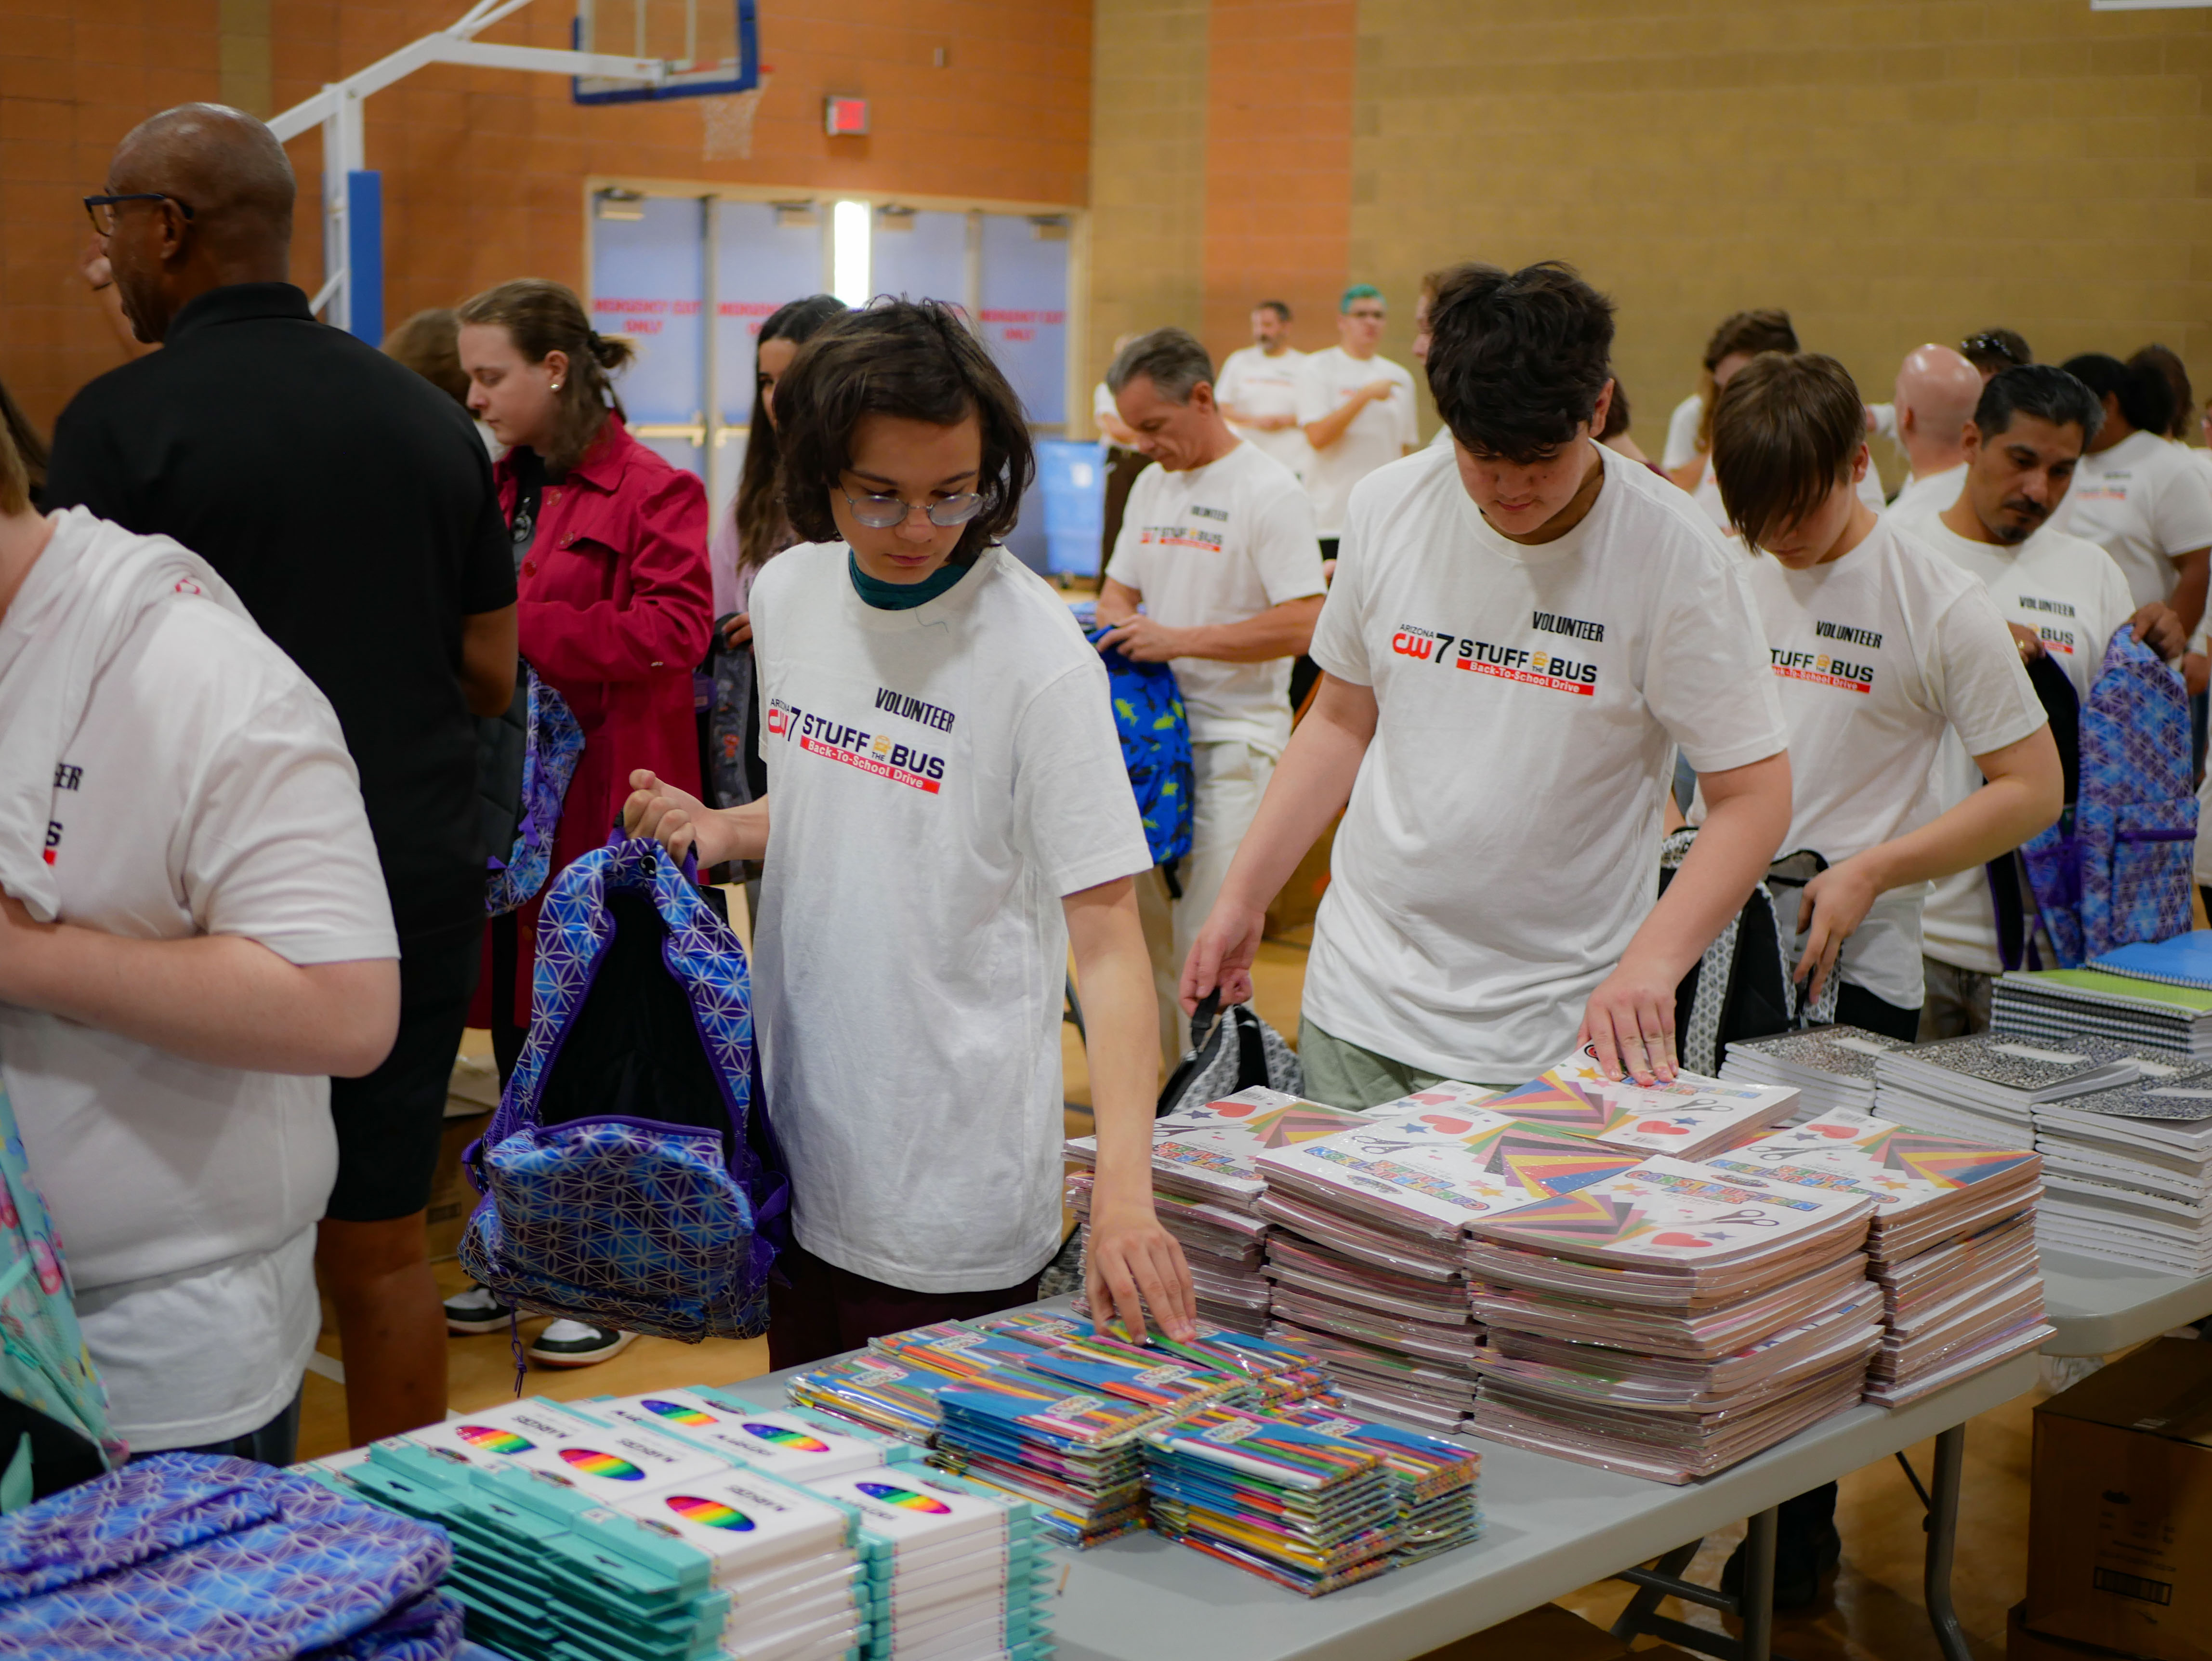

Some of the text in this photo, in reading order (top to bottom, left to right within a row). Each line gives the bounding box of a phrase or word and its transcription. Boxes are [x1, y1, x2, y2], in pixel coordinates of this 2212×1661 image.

[2019, 595, 2075, 617] VOLUNTEER
[1400, 624, 1434, 639] ARIZONA
[1531, 611, 1605, 643] VOLUNTEER
[1816, 620, 1883, 649] VOLUNTEER
[2041, 627, 2074, 645] BUS
[1435, 633, 1455, 664] 7
[1459, 639, 1529, 668] STUFF
[1532, 665, 1544, 674] THE
[1548, 658, 1598, 683] BUS
[1769, 649, 1814, 669] TUFF
[1830, 659, 1874, 682] BUS
[1470, 662, 1580, 694] Back-To-School Drive
[1773, 667, 1858, 690] ack-To-School Drive
[770, 698, 790, 713] ARIZONA
[875, 687, 955, 734] VOLUNTEER
[788, 707, 802, 742] 7
[803, 713, 871, 752] STUFF
[871, 751, 885, 762] THE
[890, 744, 945, 779] BUS
[808, 740, 923, 789] Back-To-School Drive
[1304, 1146, 1490, 1211] CONSTRUCTION
[1374, 1160, 1456, 1190] PAPER
[1625, 1170, 1823, 1211] CONSTRUCTION
[1776, 1165, 1861, 1188] PAPER
